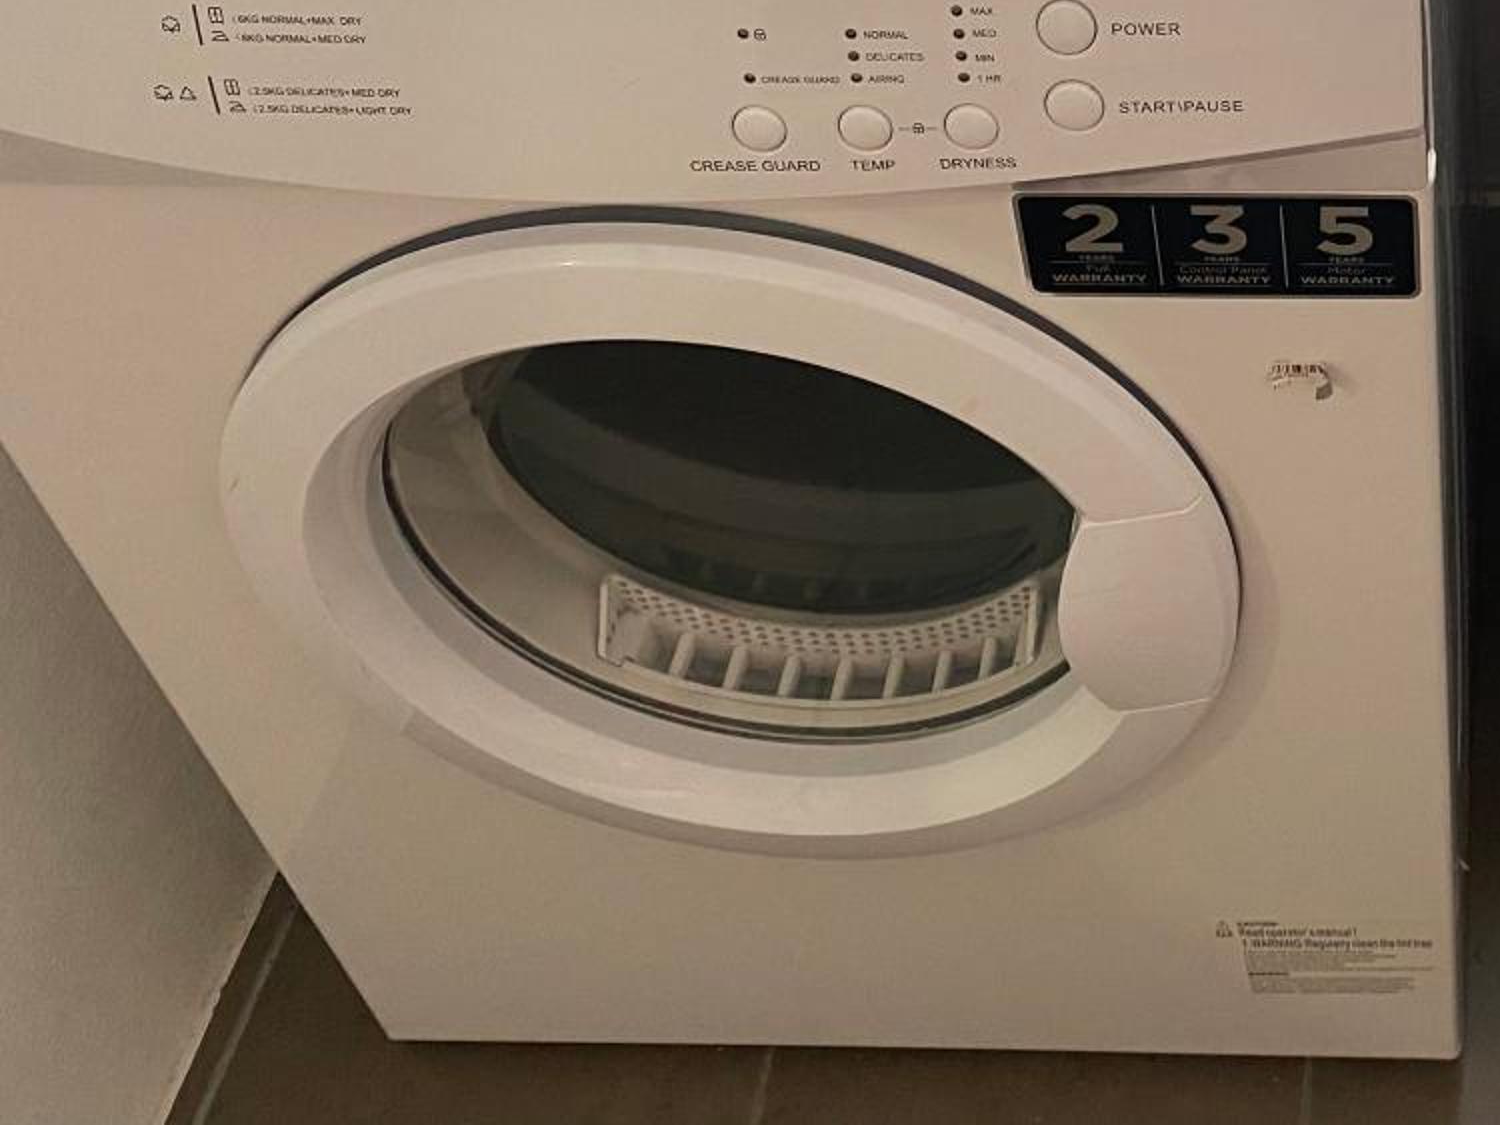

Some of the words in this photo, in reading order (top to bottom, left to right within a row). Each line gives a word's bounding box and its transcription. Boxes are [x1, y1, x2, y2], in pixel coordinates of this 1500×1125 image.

[970, 6, 992, 15] MAX
[339, 16, 362, 26] DRY
[973, 28, 997, 38] MED
[1110, 22, 1182, 36] POWER
[862, 30, 909, 40] NORMAL
[865, 52, 925, 62] DELICATES
[975, 53, 996, 62] MIN
[760, 75, 801, 84] CREASE
[867, 74, 905, 84] AIRING
[985, 74, 1001, 83] HR
[377, 87, 400, 98] DRY
[689, 159, 756, 173] CREASE
[761, 159, 822, 173] GUARD
[850, 159, 896, 172] TEMP
[939, 157, 1018, 171] DRYNESS
[1062, 203, 1124, 252] 2
[1189, 204, 1248, 255] 3
[1315, 206, 1374, 256] 5
[1328, 256, 1366, 264] YEARS
[1179, 265, 1226, 274] Control
[1229, 266, 1268, 274] Panel
[1327, 266, 1366, 275] Motor
[1053, 273, 1148, 285] WARRANTY
[1176, 275, 1272, 285] WARRANTY
[1301, 276, 1395, 285] WARRANTY
